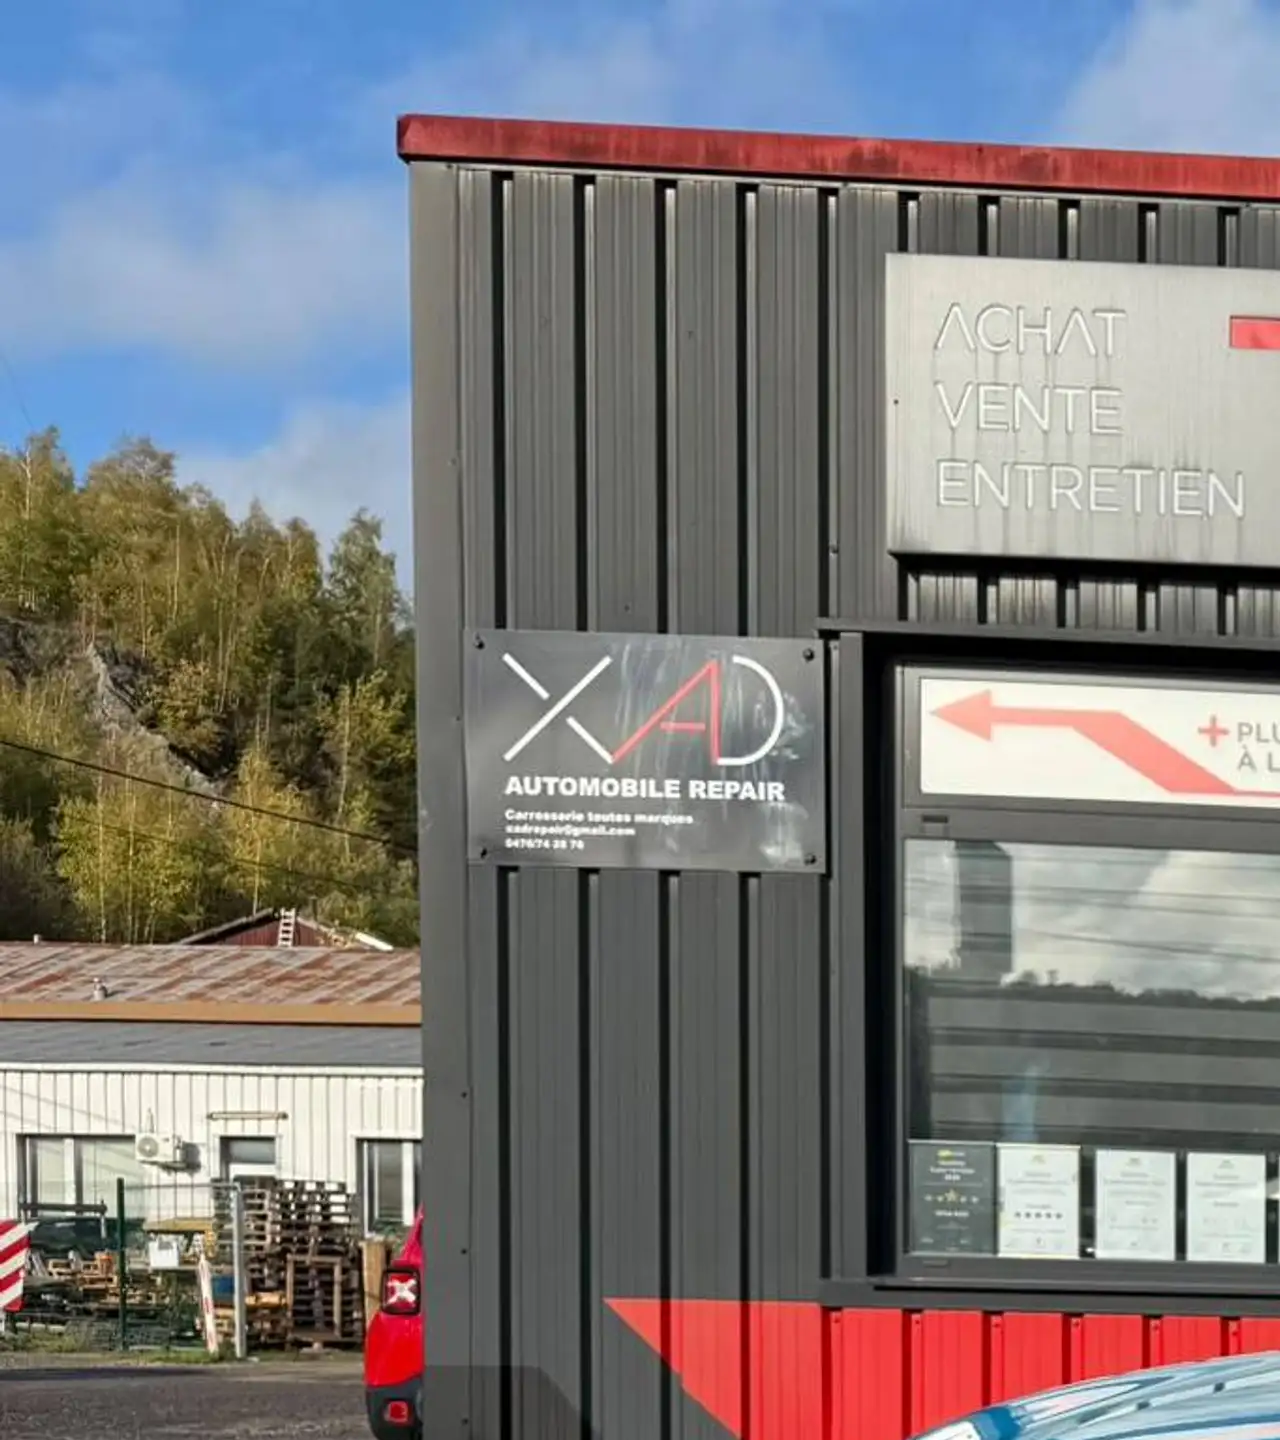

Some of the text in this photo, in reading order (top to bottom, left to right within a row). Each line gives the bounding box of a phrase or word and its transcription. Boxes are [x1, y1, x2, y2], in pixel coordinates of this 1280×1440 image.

[934, 302, 1127, 356] ACHAT
[935, 382, 1123, 435] VENTE
[937, 458, 1247, 518] ENTRETIEN
[502, 653, 786, 766] XAD
[1236, 745, 1258, 772] À
[505, 776, 785, 801] AUTOMOBILE REPAIR
[505, 808, 694, 826] Carrosserie toutes marques
